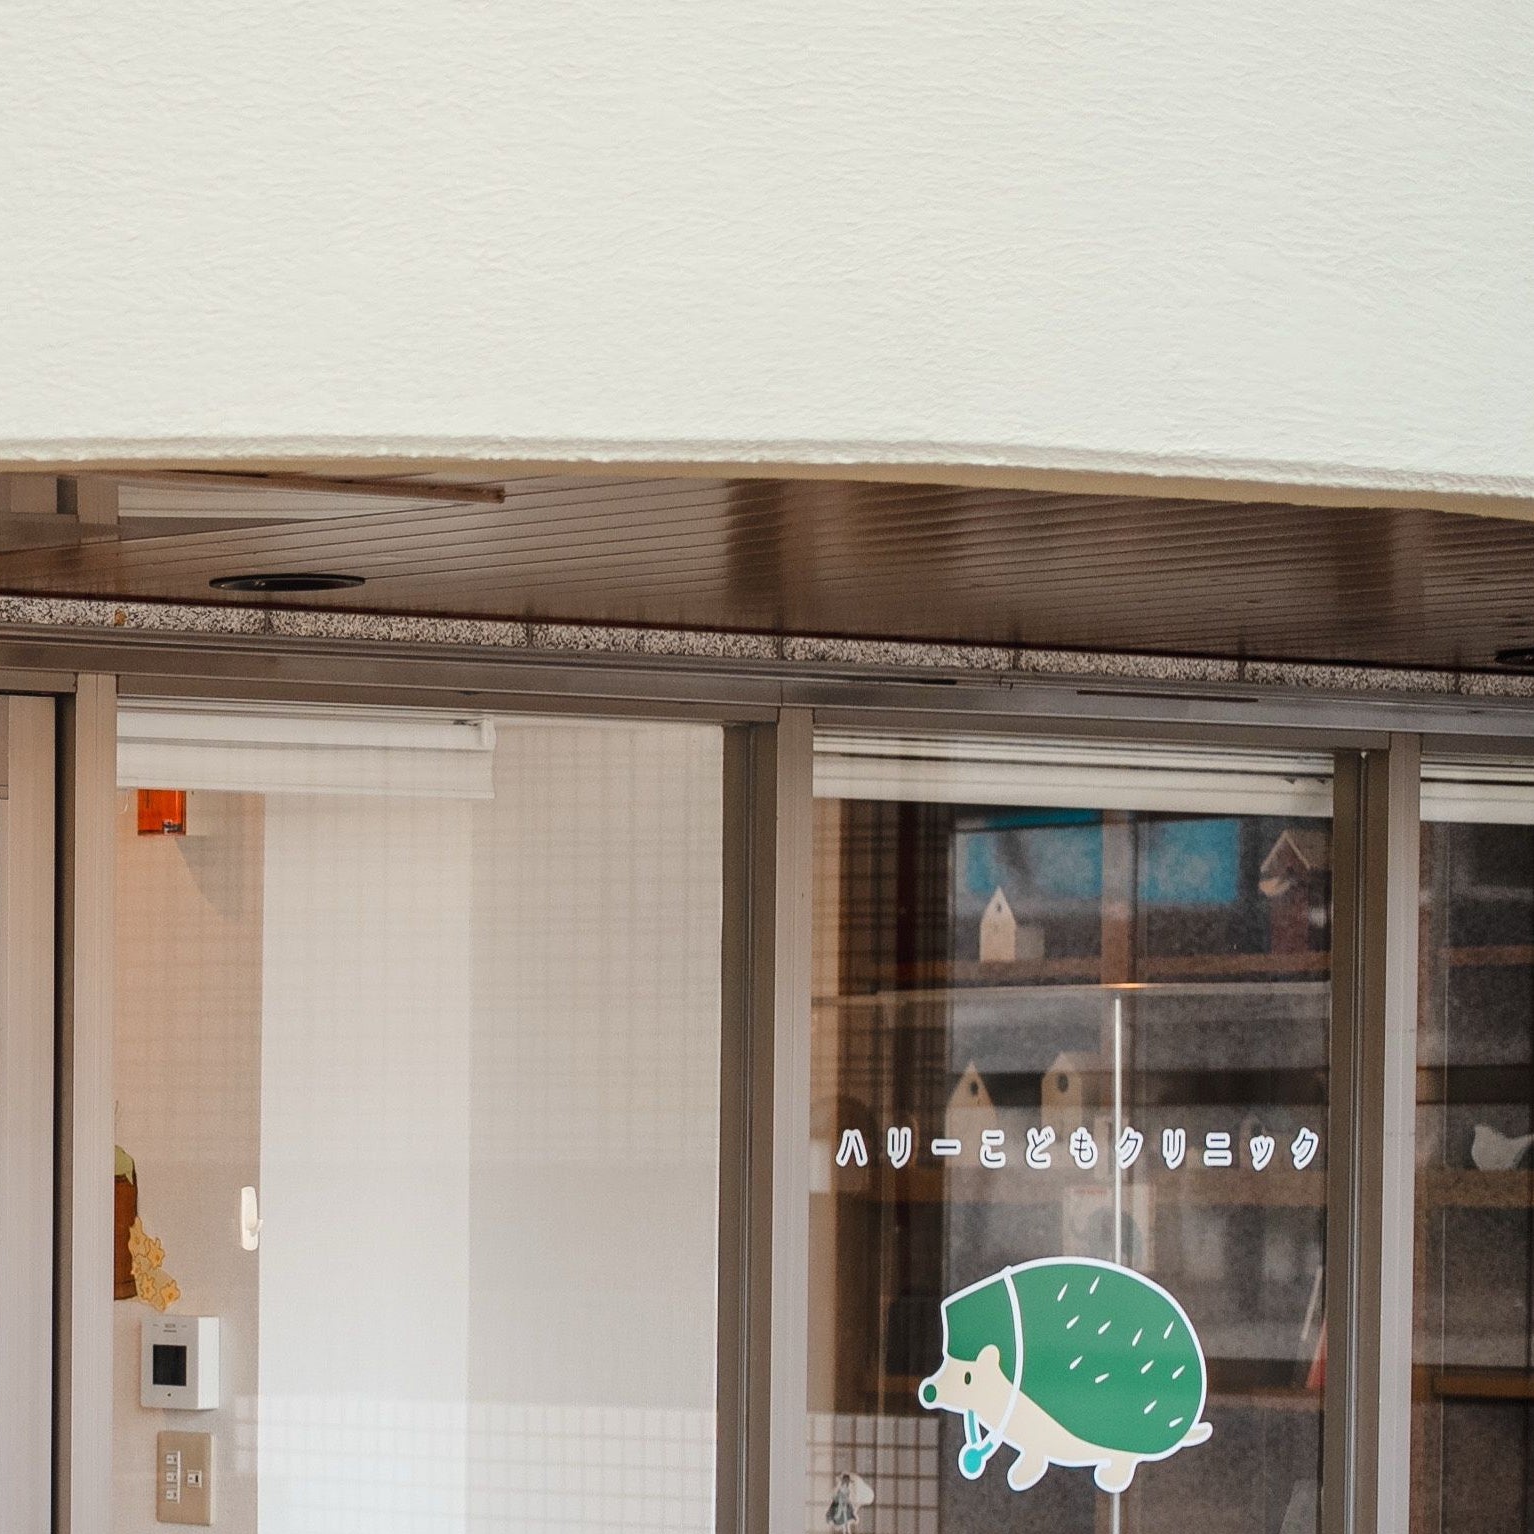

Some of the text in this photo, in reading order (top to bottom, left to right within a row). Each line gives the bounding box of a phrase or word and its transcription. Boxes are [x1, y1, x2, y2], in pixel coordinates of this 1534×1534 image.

[835, 1126, 1320, 1171] ハリーこどもクリニック
